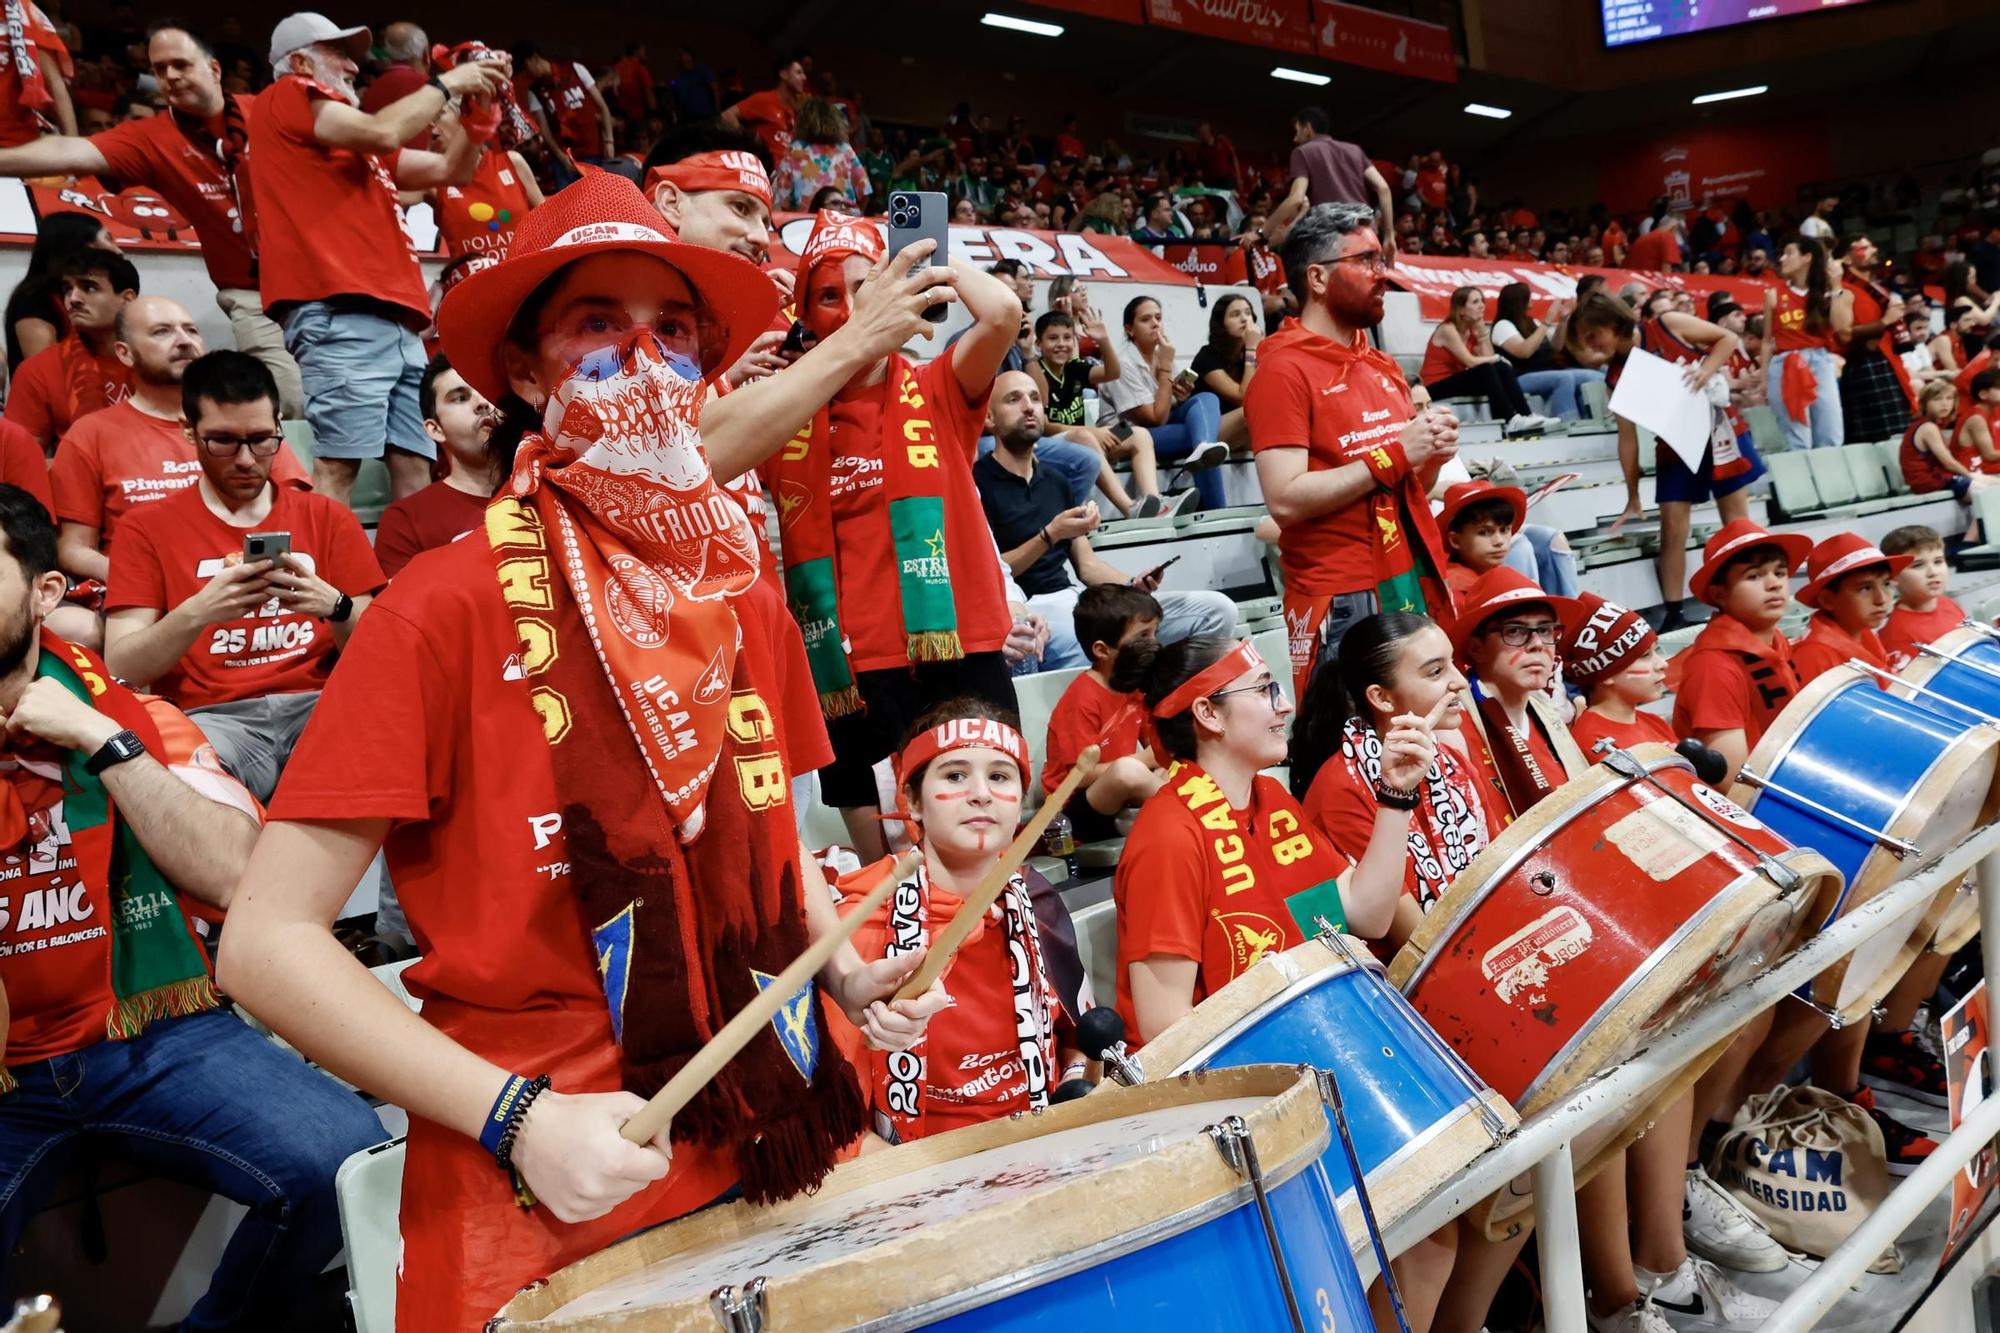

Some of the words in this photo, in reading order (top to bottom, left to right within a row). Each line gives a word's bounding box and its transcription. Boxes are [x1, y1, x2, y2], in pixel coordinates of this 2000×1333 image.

[571, 225, 620, 243] UCAM
[209, 628, 247, 655] 25
[250, 618, 315, 653] AÑOS
[630, 680, 678, 761] UNIVERSIDAD
[643, 674, 699, 753] UCAM
[937, 718, 1020, 760] UCAM
[725, 688, 787, 812] CB
[1177, 773, 1256, 897] UCAM
[1269, 808, 1313, 866] CB
[15, 940, 35, 955] POR
[36, 936, 49, 950] EL
[1234, 931, 1248, 965] UCAM
[888, 1050, 921, 1117] 20
